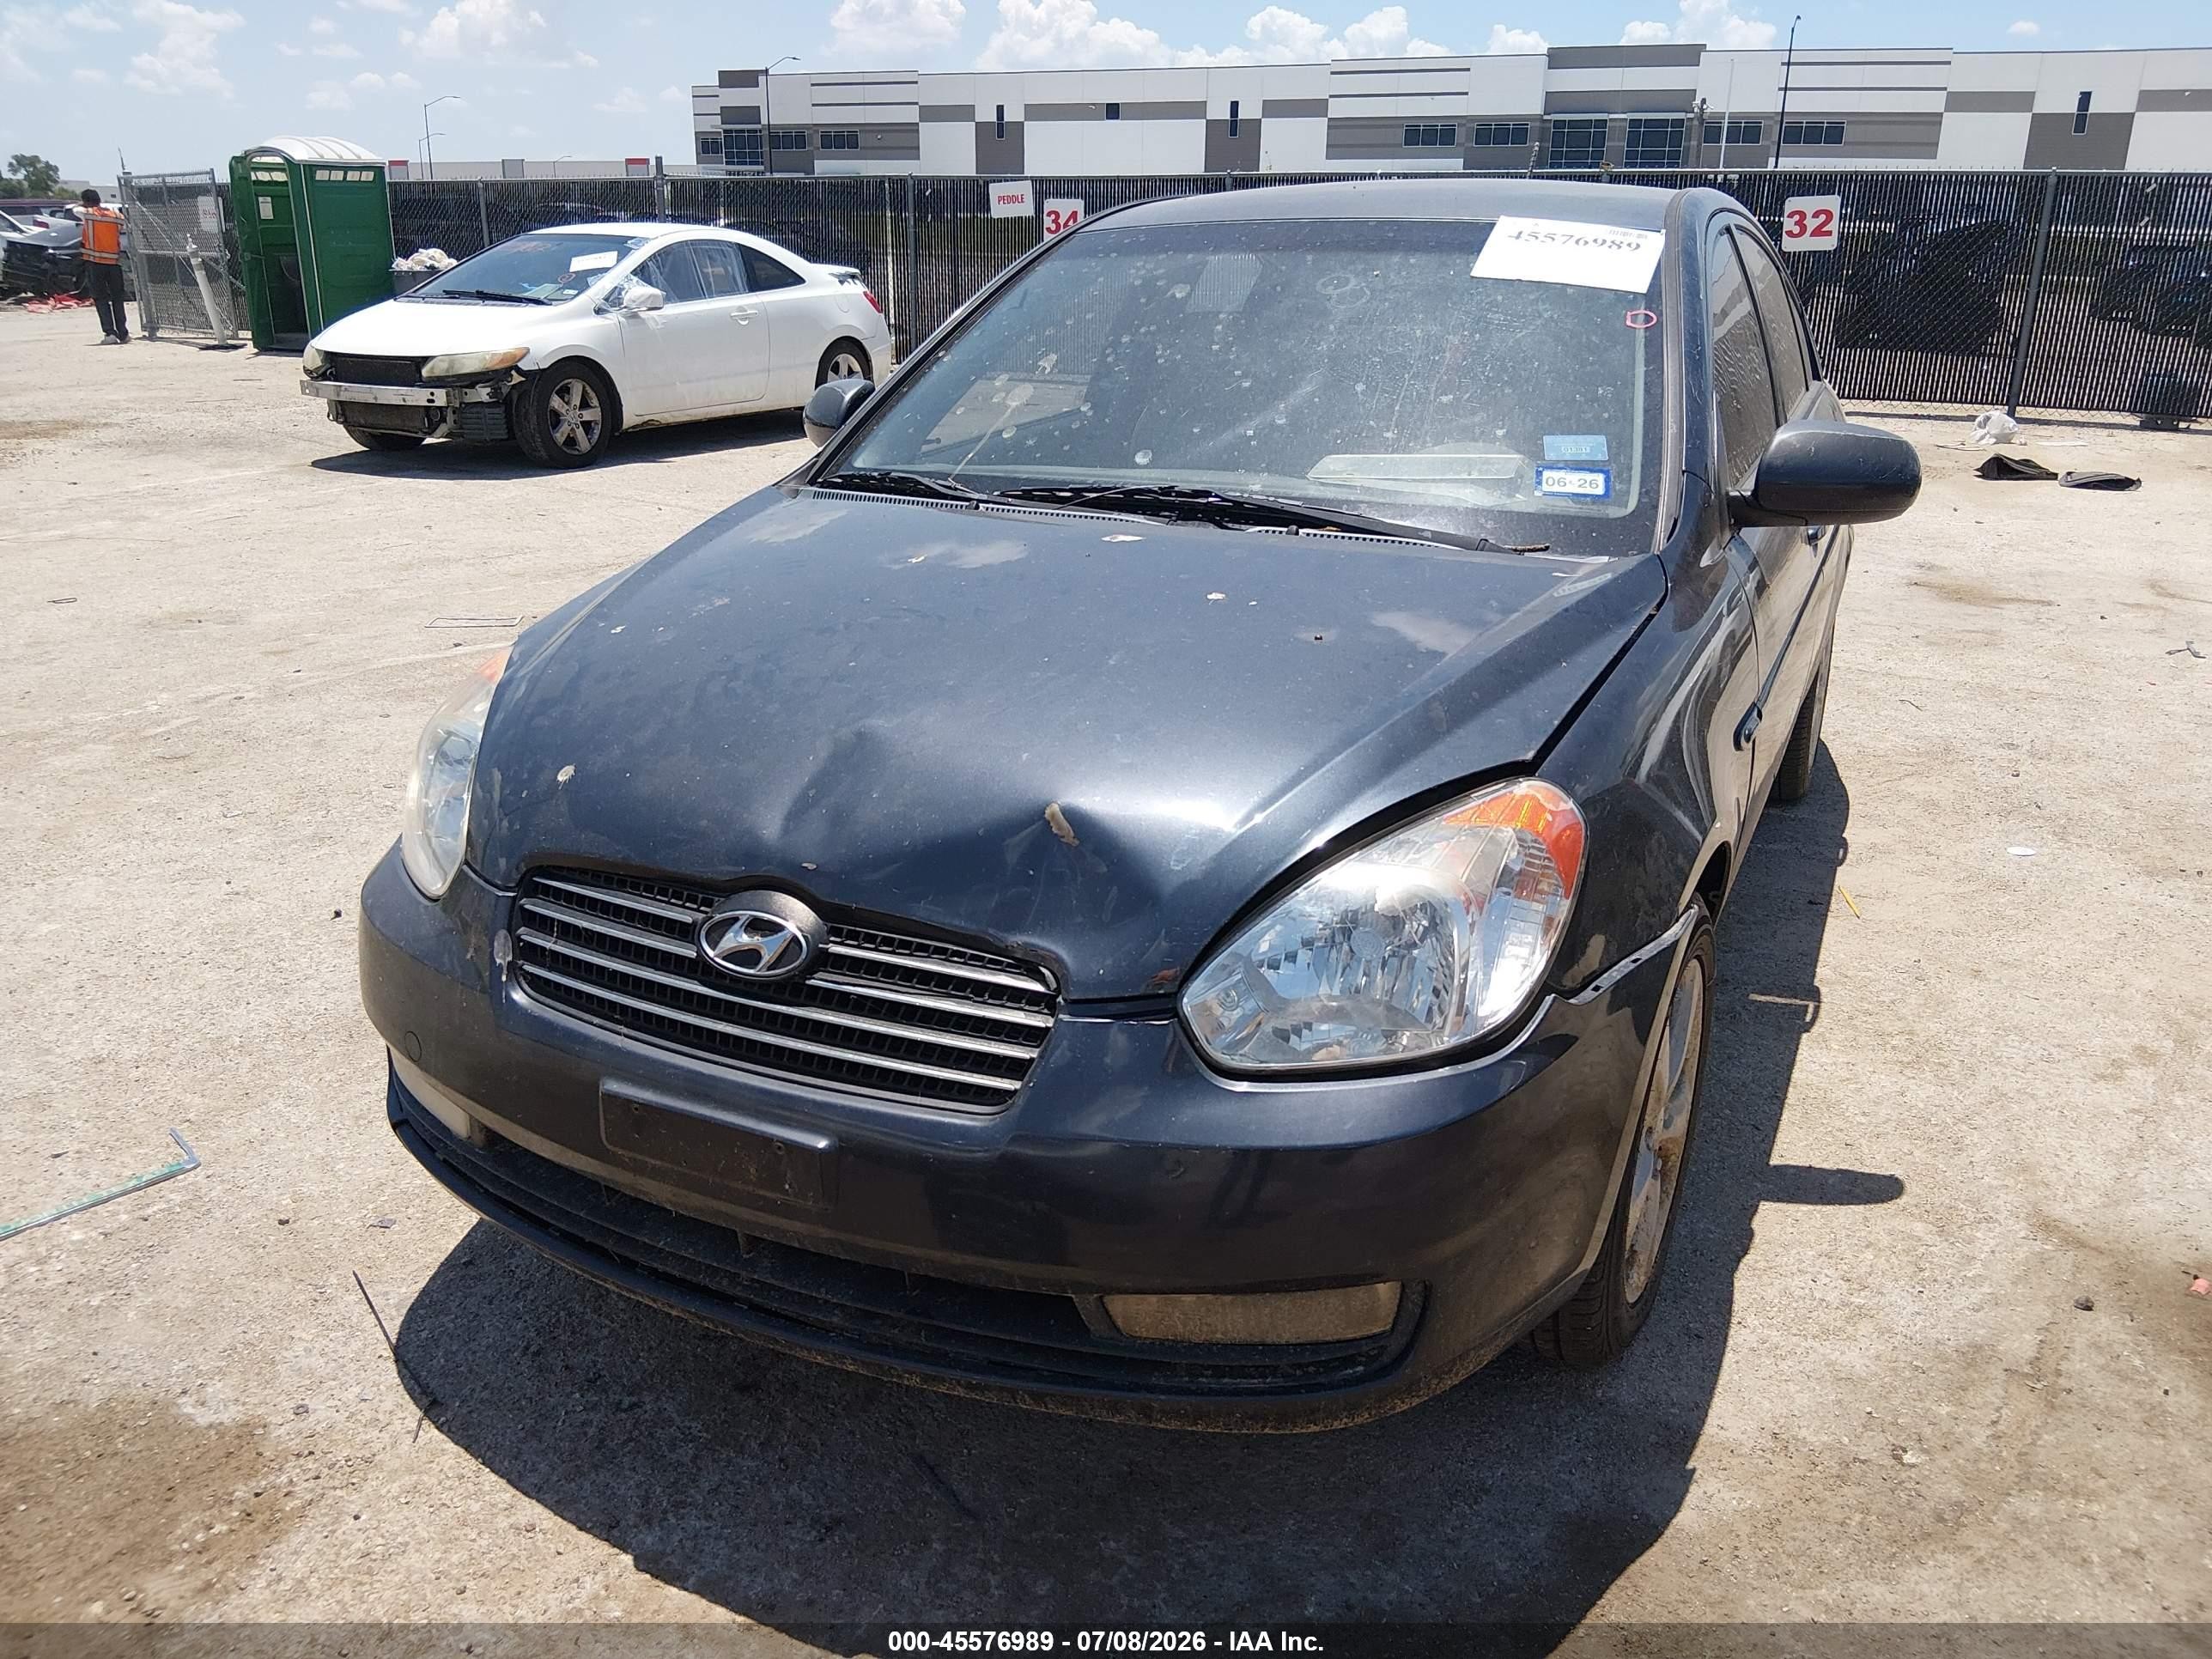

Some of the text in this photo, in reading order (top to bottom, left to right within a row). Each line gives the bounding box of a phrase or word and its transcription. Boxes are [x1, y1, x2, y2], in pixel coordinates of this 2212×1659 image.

[997, 193, 1025, 205] PEDDLE
[1045, 210, 1079, 234] 34
[1784, 209, 1834, 239] 32
[1507, 229, 1642, 252] 45576989
